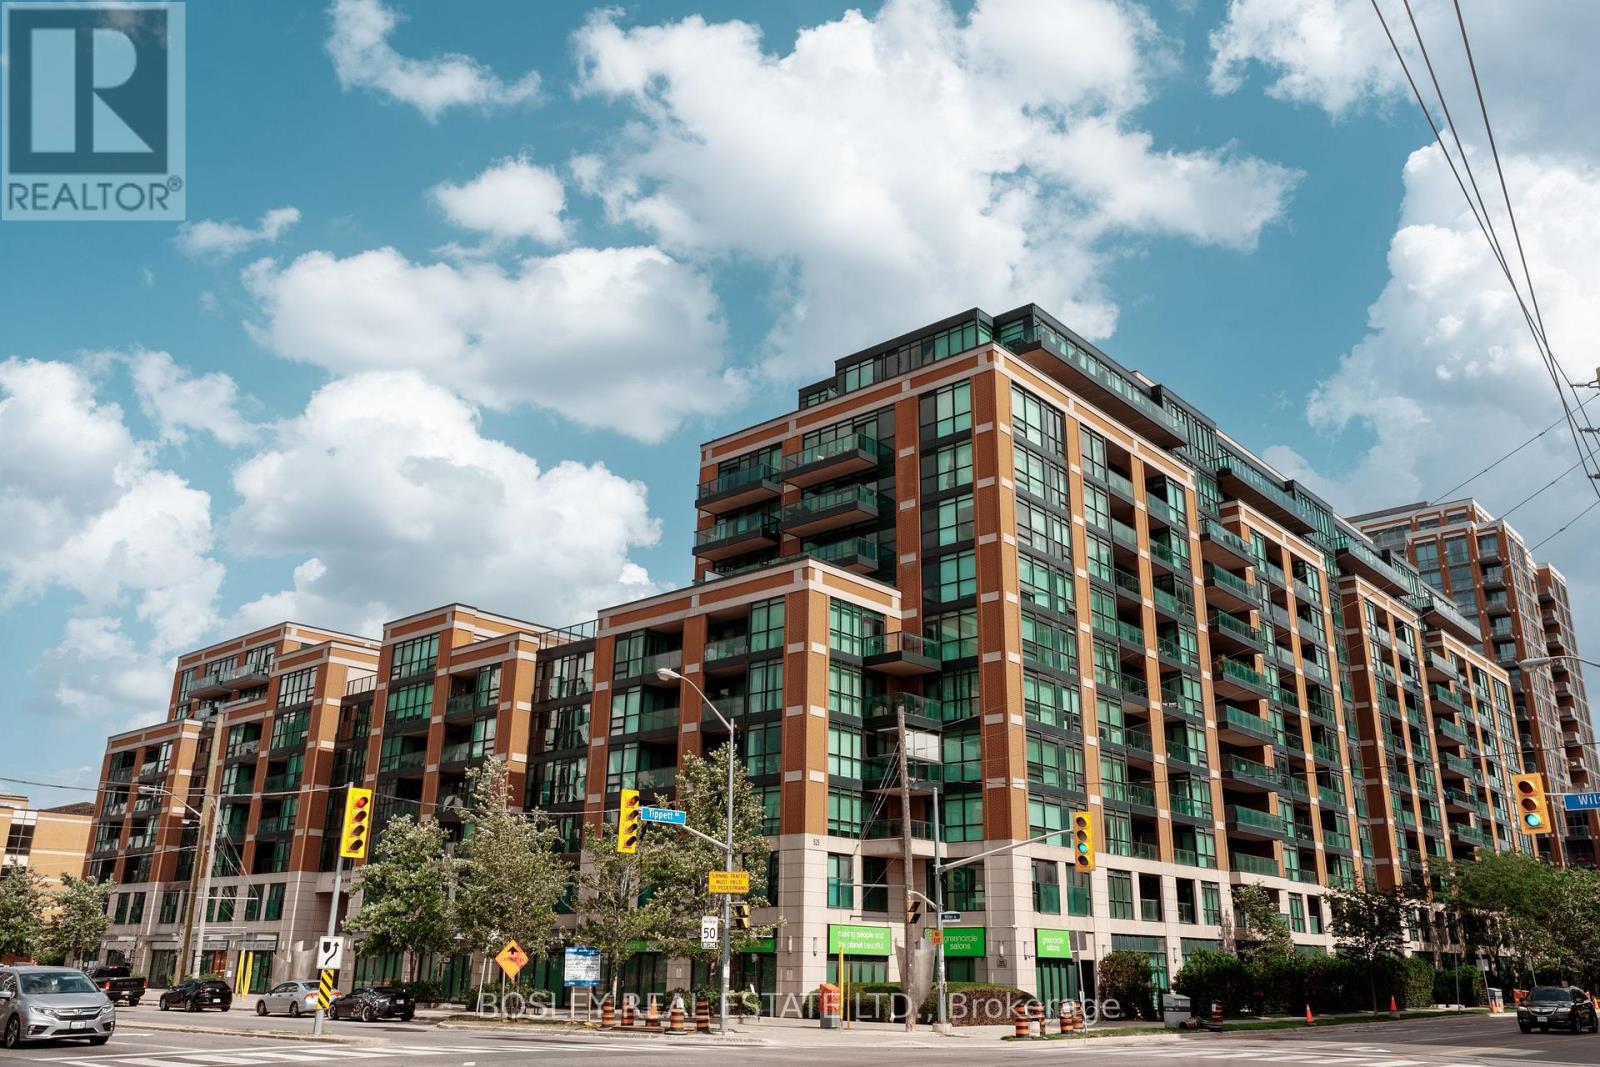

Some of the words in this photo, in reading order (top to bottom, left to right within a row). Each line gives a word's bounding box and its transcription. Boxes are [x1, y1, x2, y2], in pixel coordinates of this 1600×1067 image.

[1577, 793, 1600, 805] Wil
[649, 809, 673, 820] Tippett
[703, 927, 716, 939] 50
